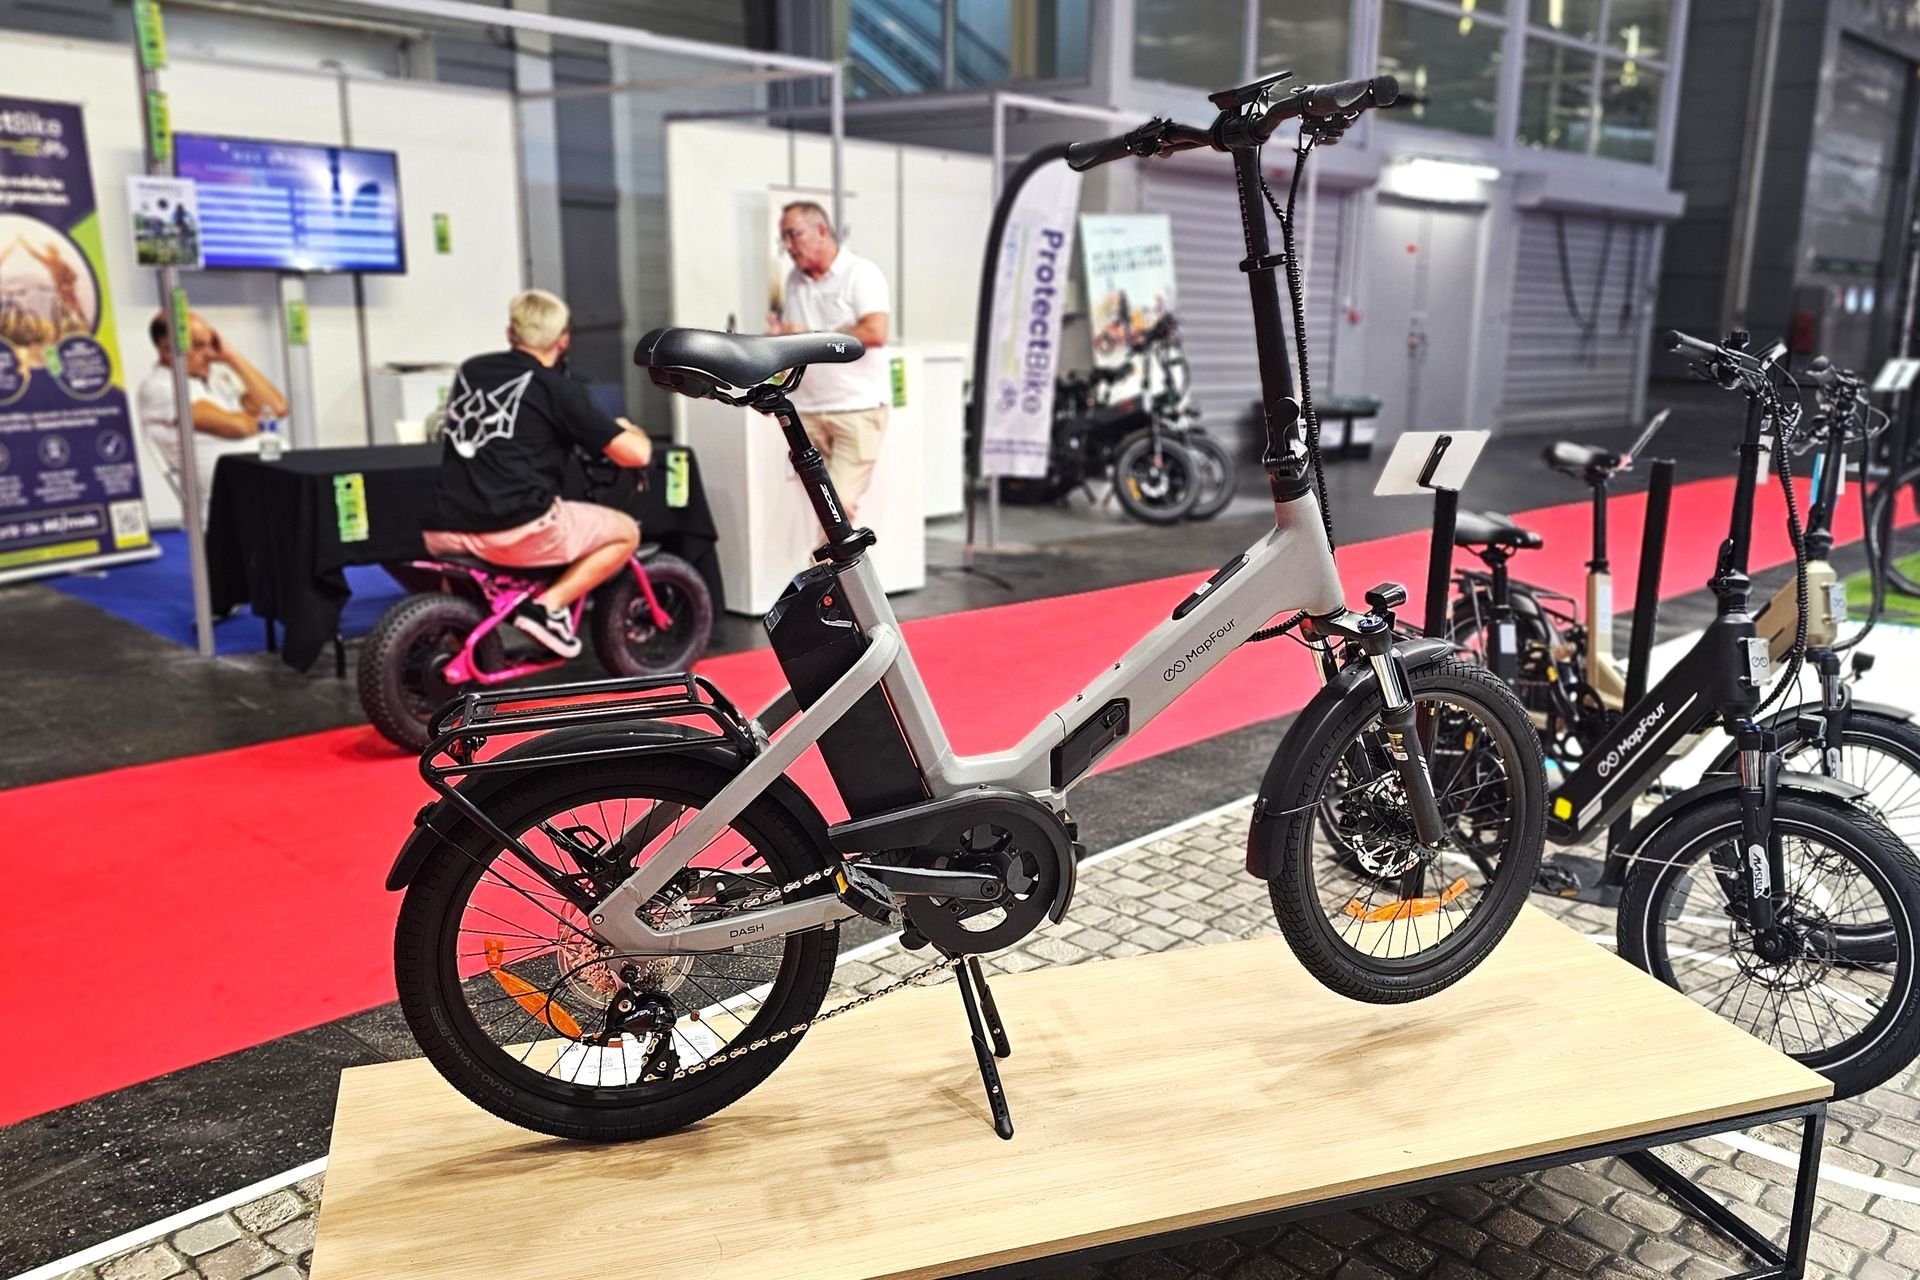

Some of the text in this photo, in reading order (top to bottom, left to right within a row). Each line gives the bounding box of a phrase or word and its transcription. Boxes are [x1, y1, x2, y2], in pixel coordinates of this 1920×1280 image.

[1021, 228, 1064, 416] ProtectBike
[1185, 618, 1237, 663] MapFour
[1617, 702, 1666, 757] MapFour
[730, 923, 765, 938] DASH
[447, 1037, 515, 1097] CHAO YANG
